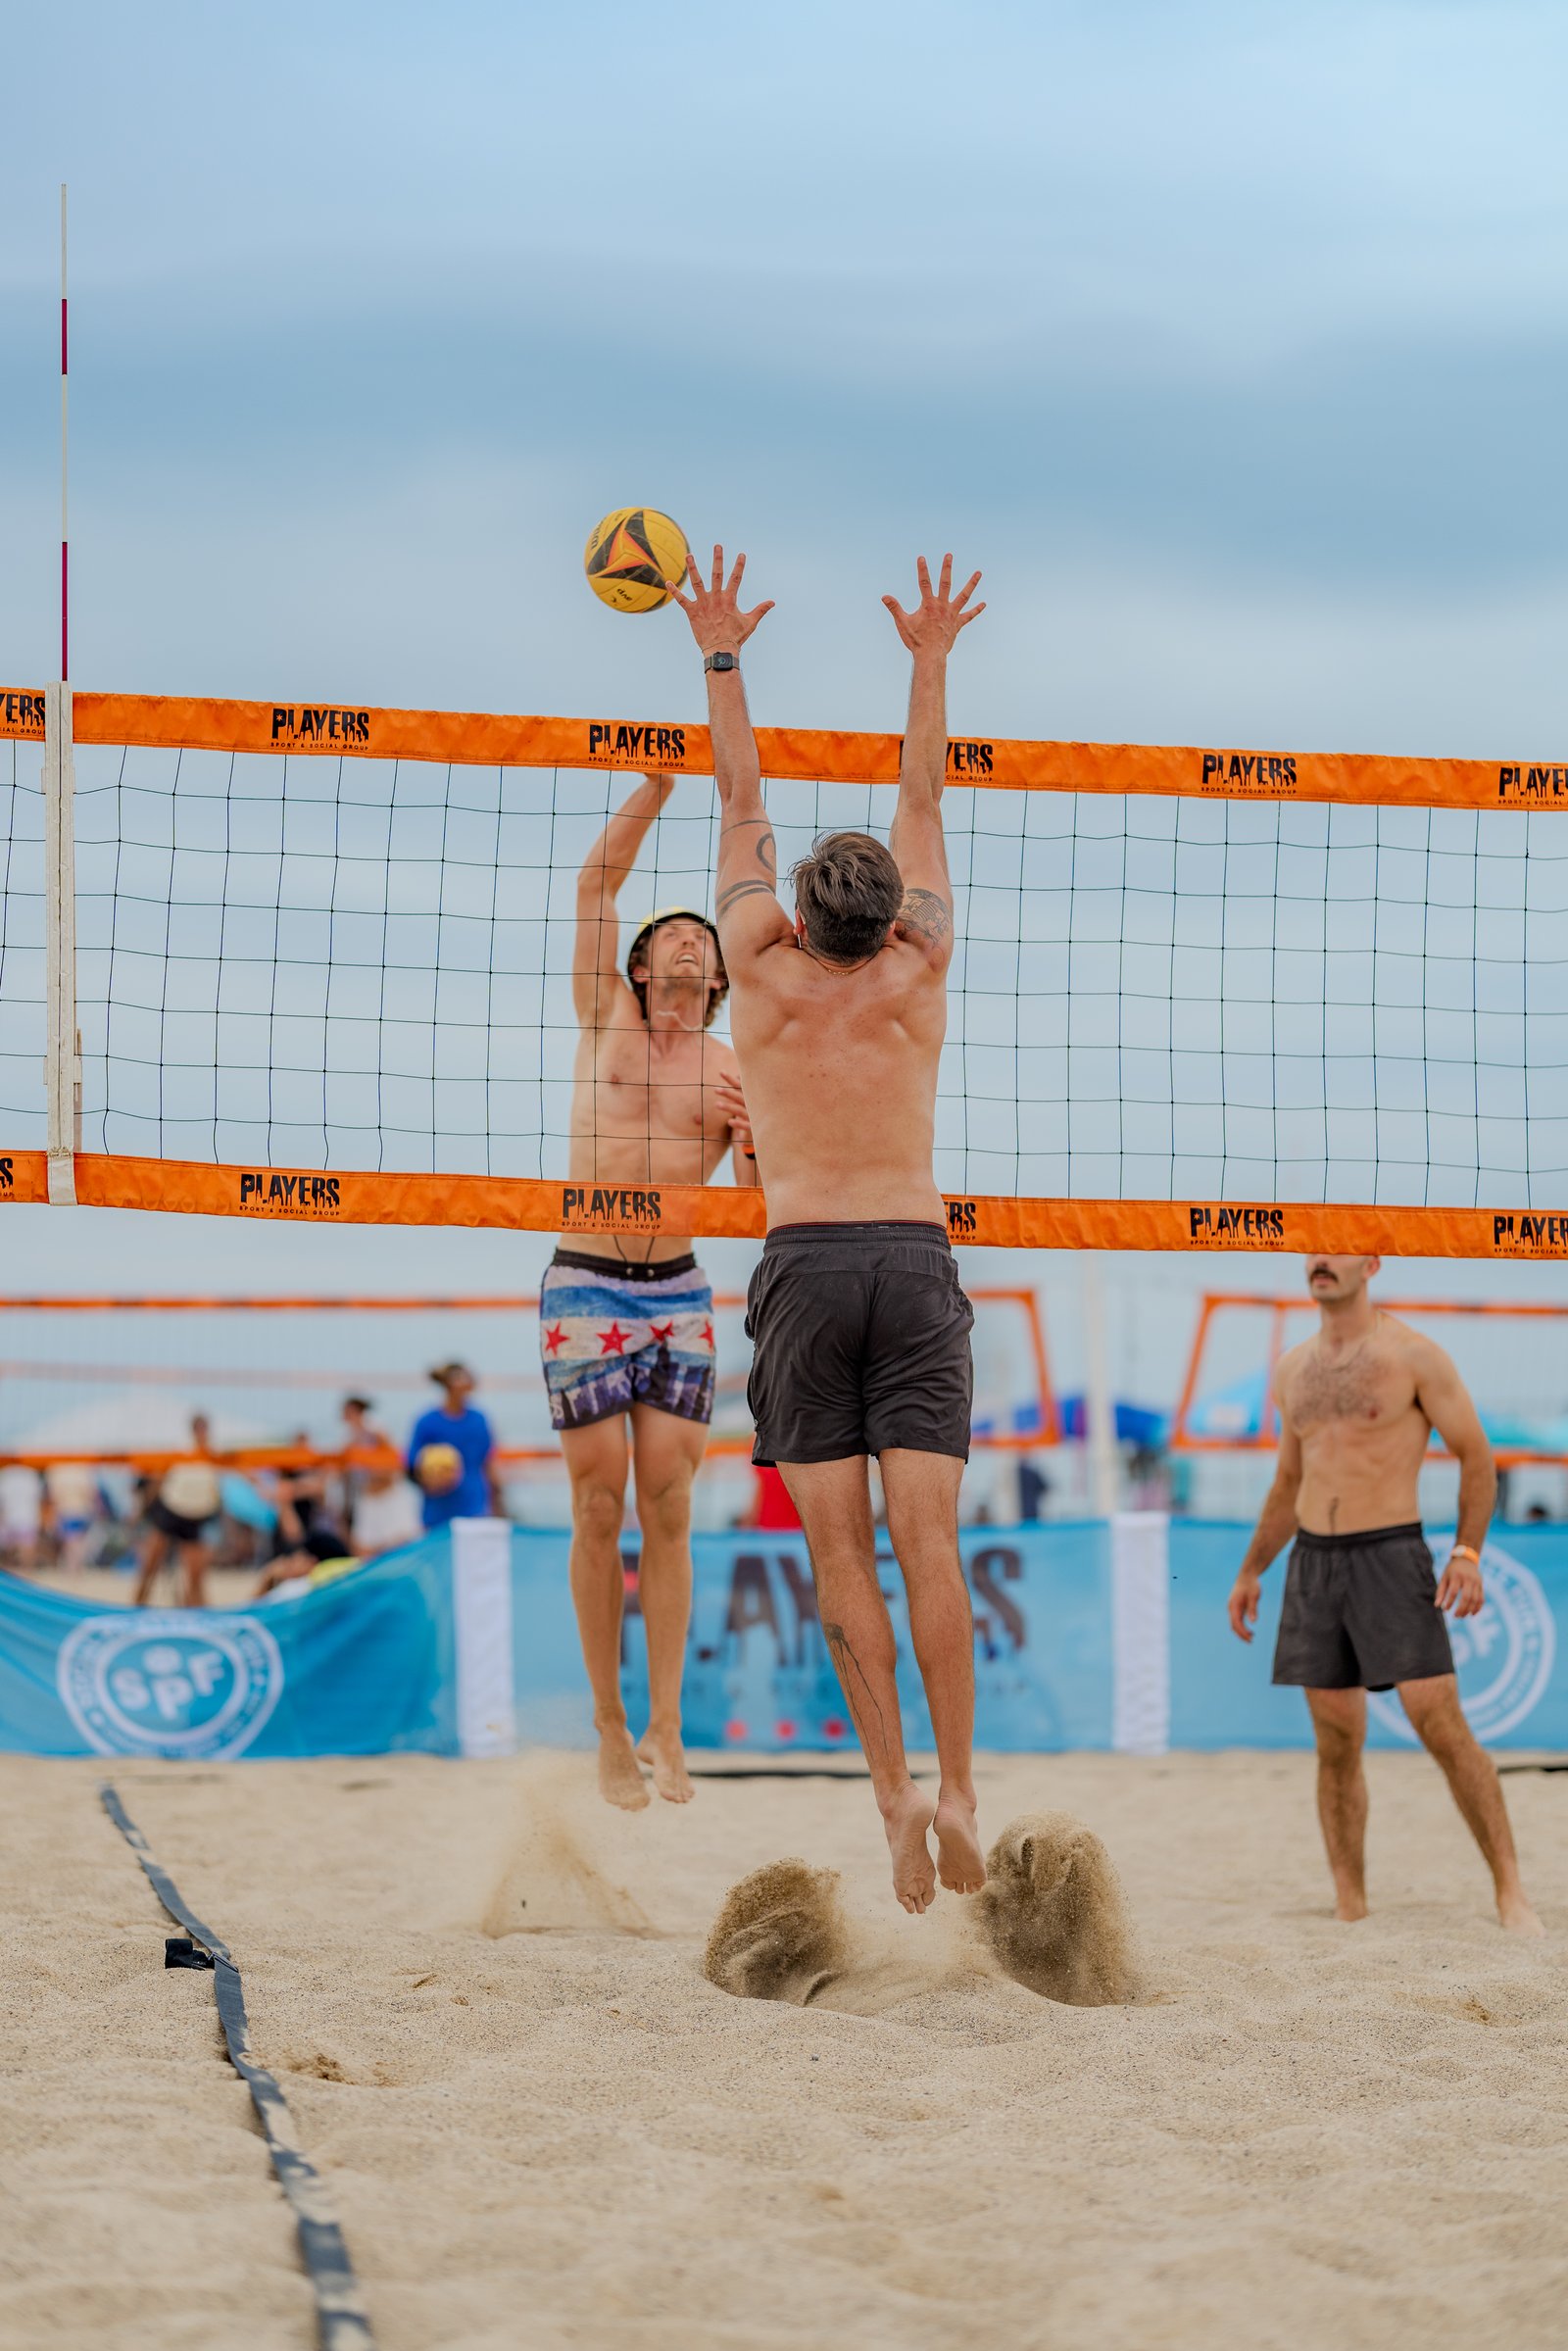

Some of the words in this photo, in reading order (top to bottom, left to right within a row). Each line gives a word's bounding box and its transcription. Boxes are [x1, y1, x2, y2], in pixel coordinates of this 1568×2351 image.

[271, 708, 369, 743] PLAYERS
[589, 724, 685, 759] PLAYERS
[1202, 755, 1297, 787] PLAYERS
[1499, 767, 1568, 798] PLAYE
[240, 1174, 340, 1208] PLAYERS
[563, 1188, 662, 1222] PLAYERS
[1190, 1207, 1284, 1239] PLAYERS
